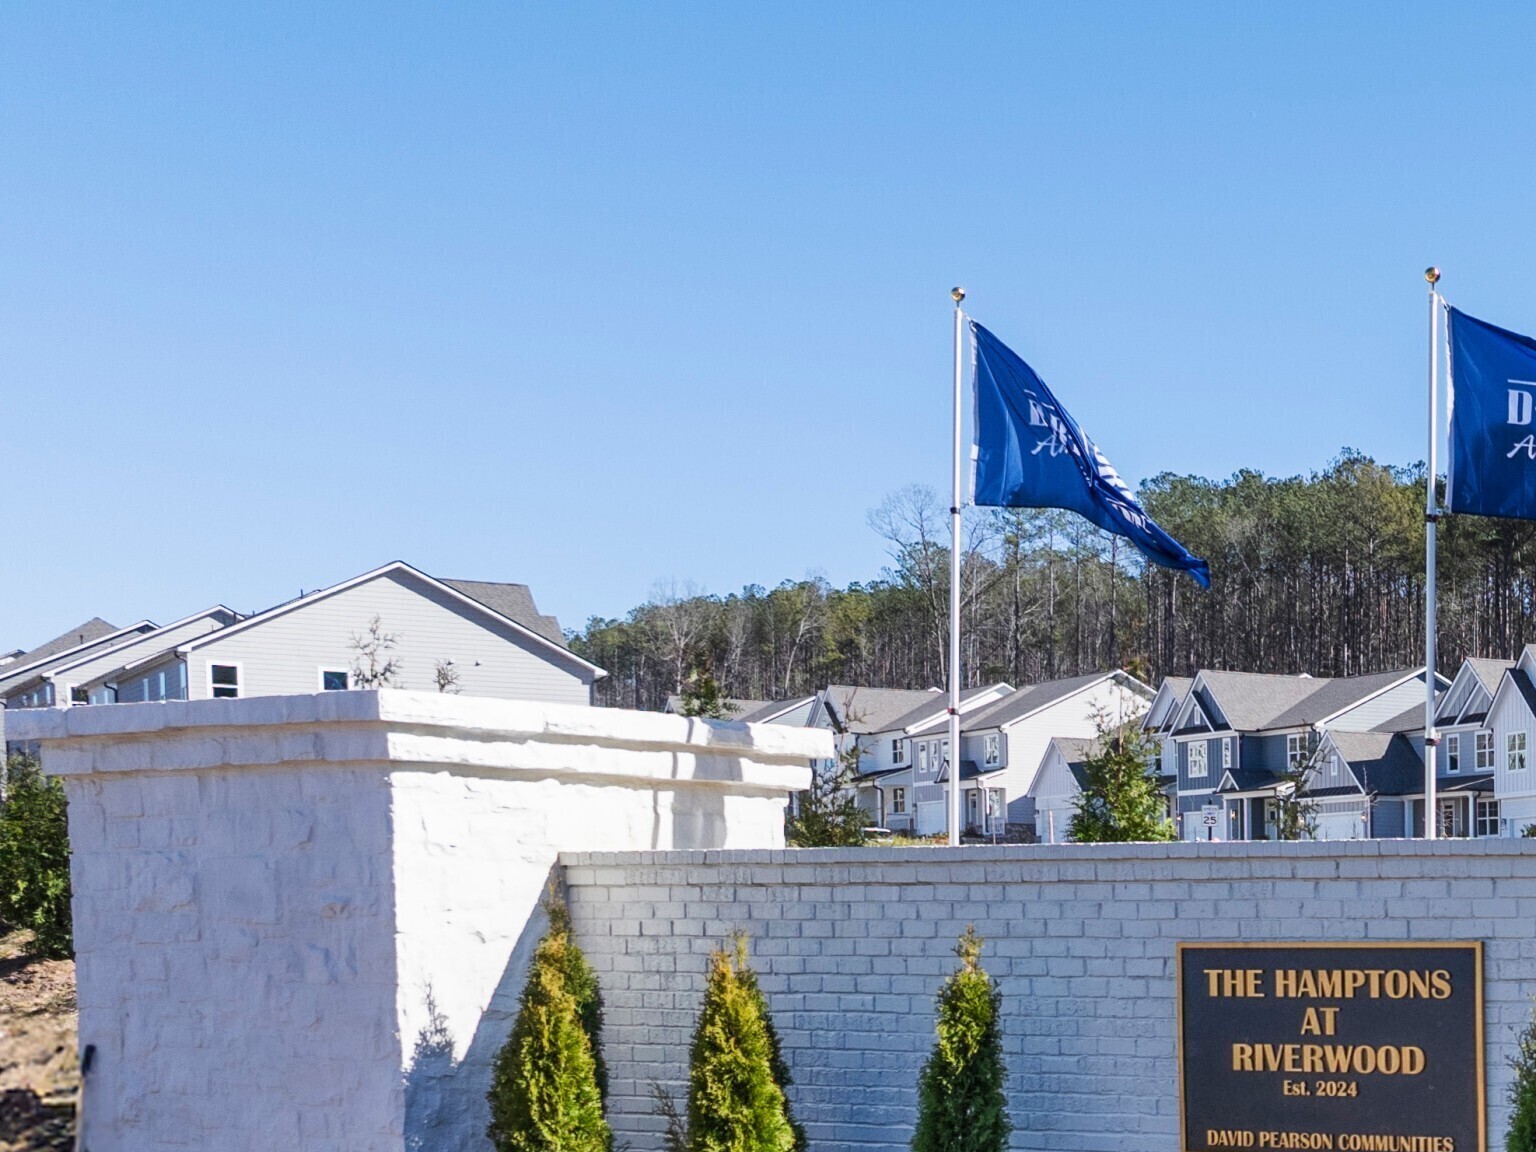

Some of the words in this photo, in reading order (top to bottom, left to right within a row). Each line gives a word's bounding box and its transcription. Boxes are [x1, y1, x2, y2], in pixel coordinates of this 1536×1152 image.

[1203, 816, 1217, 825] 25
[1203, 969, 1265, 997] THE
[1275, 969, 1452, 999] HAMPTONS
[1300, 1007, 1340, 1035] AT
[1232, 1043, 1426, 1075] RIVERWOOD
[1283, 1080, 1311, 1096] Est.
[1316, 1081, 1358, 1097] 2024
[1207, 1130, 1254, 1147] DAVID
[1259, 1132, 1333, 1149] PEARSON
[1338, 1134, 1454, 1152] COMMUNITIES
